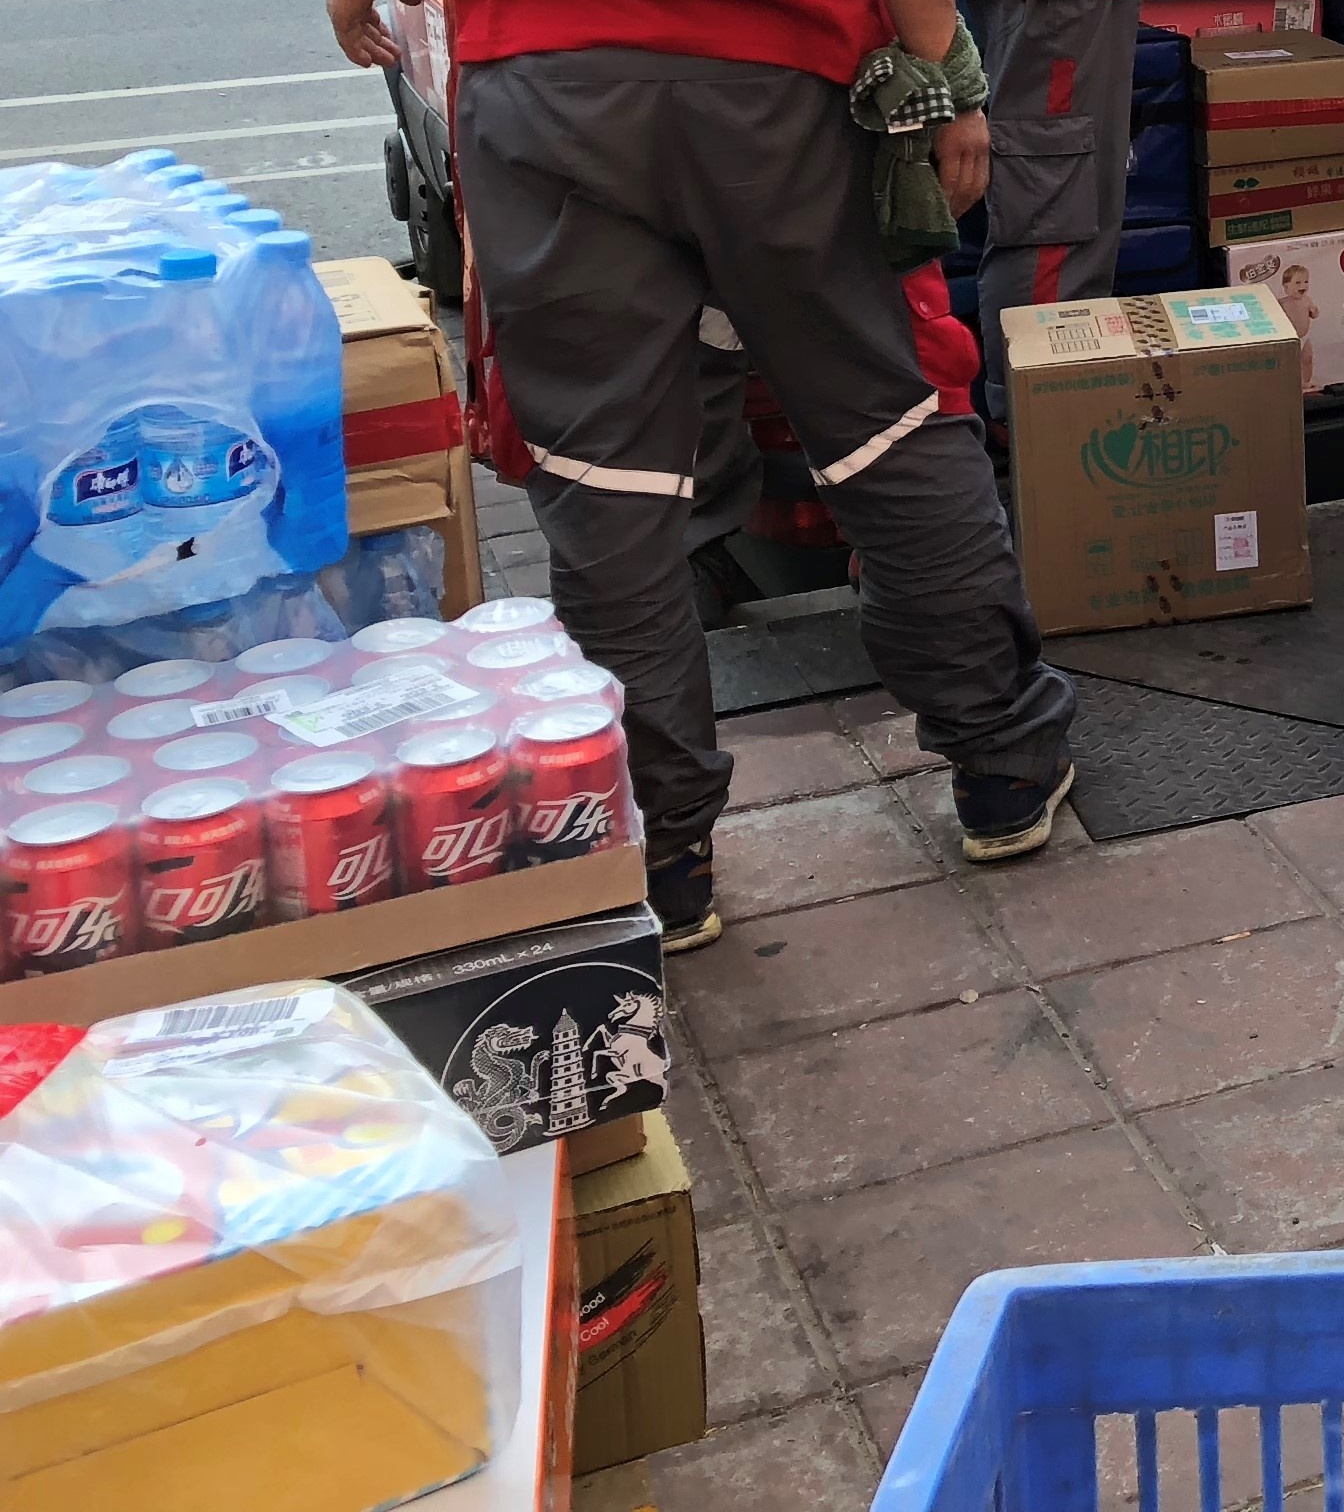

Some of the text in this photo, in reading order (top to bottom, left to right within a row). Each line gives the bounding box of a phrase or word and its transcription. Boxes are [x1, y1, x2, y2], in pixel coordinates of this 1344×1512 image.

[451, 951, 515, 976] 330mL
[530, 942, 555, 956] 24
[580, 1317, 610, 1342] Cool
